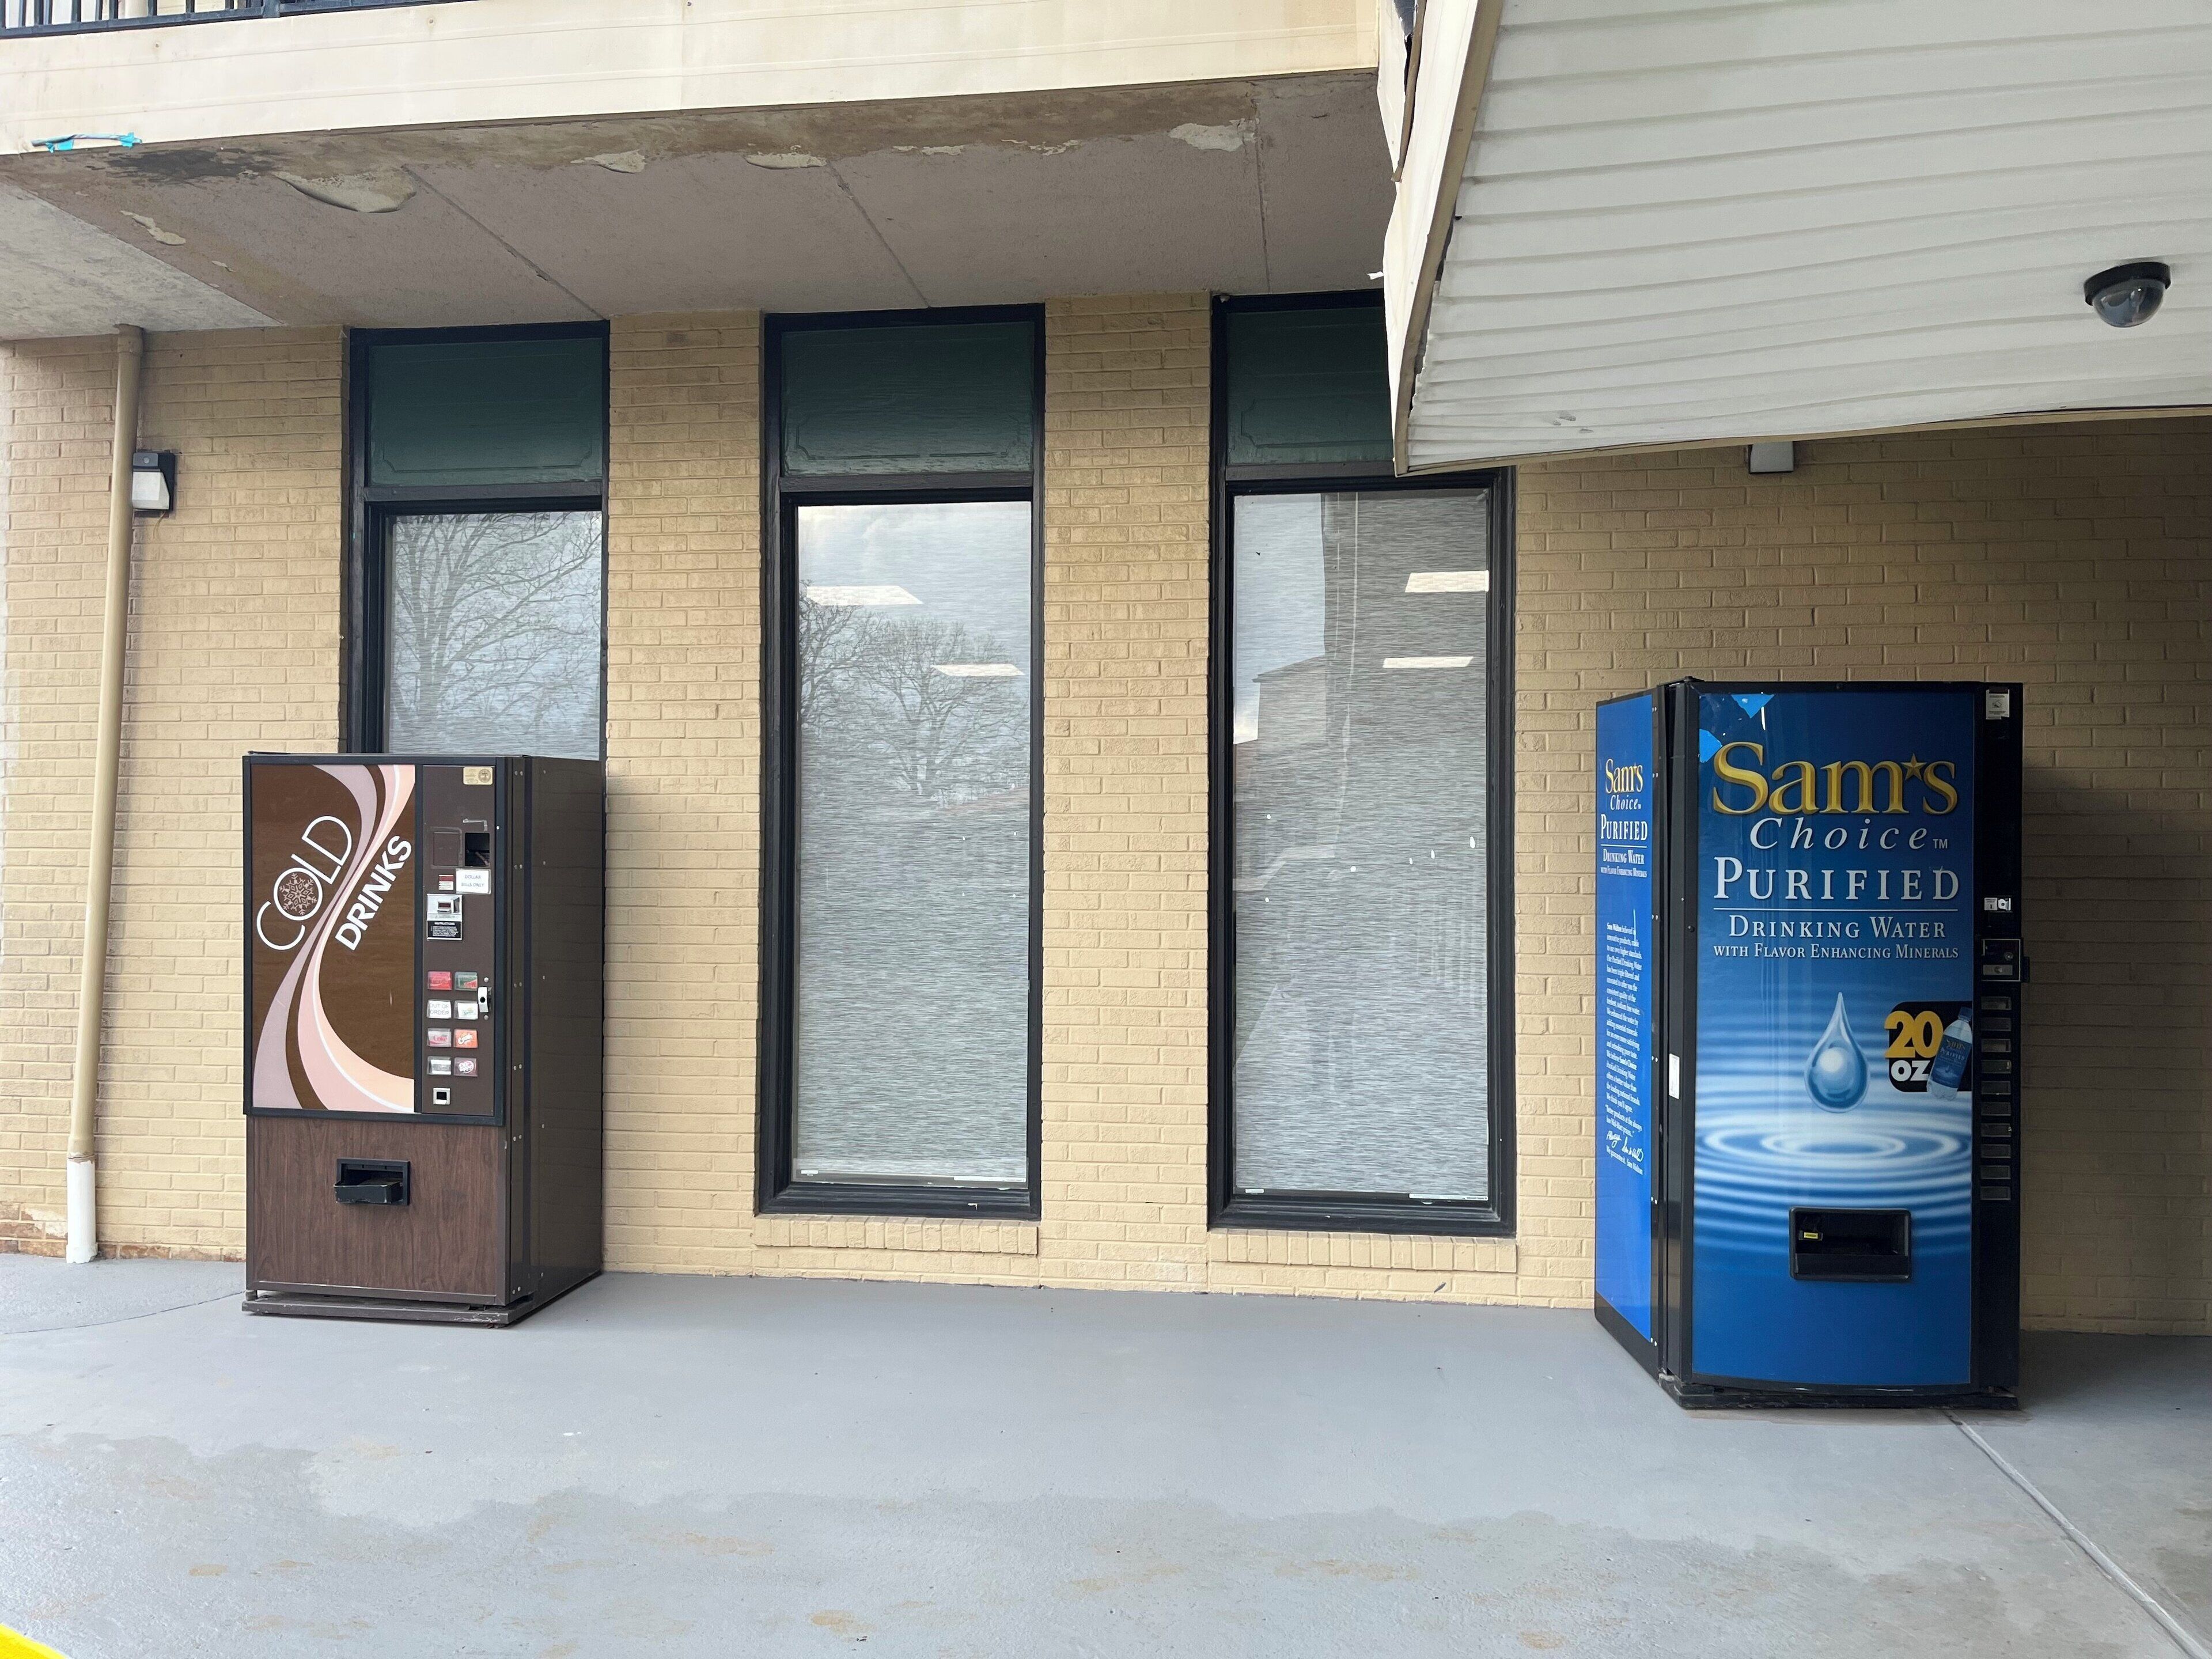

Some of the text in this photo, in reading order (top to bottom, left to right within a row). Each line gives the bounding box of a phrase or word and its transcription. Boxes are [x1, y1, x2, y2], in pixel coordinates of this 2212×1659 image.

[1610, 794, 1639, 811] Choice
[1600, 813, 1648, 841] PURIFIED
[1749, 817, 1928, 850] Choice
[256, 815, 353, 950] COLD
[335, 835, 412, 951] DRINKS
[1713, 856, 1960, 901] PURIFIED
[1729, 915, 1945, 939] DRINKING WATER
[1754, 943, 1805, 959] FLAVOR
[1810, 944, 1892, 959] ENHANCING
[1895, 944, 1959, 959] MINERALS
[1884, 1010, 1944, 1059] 20
